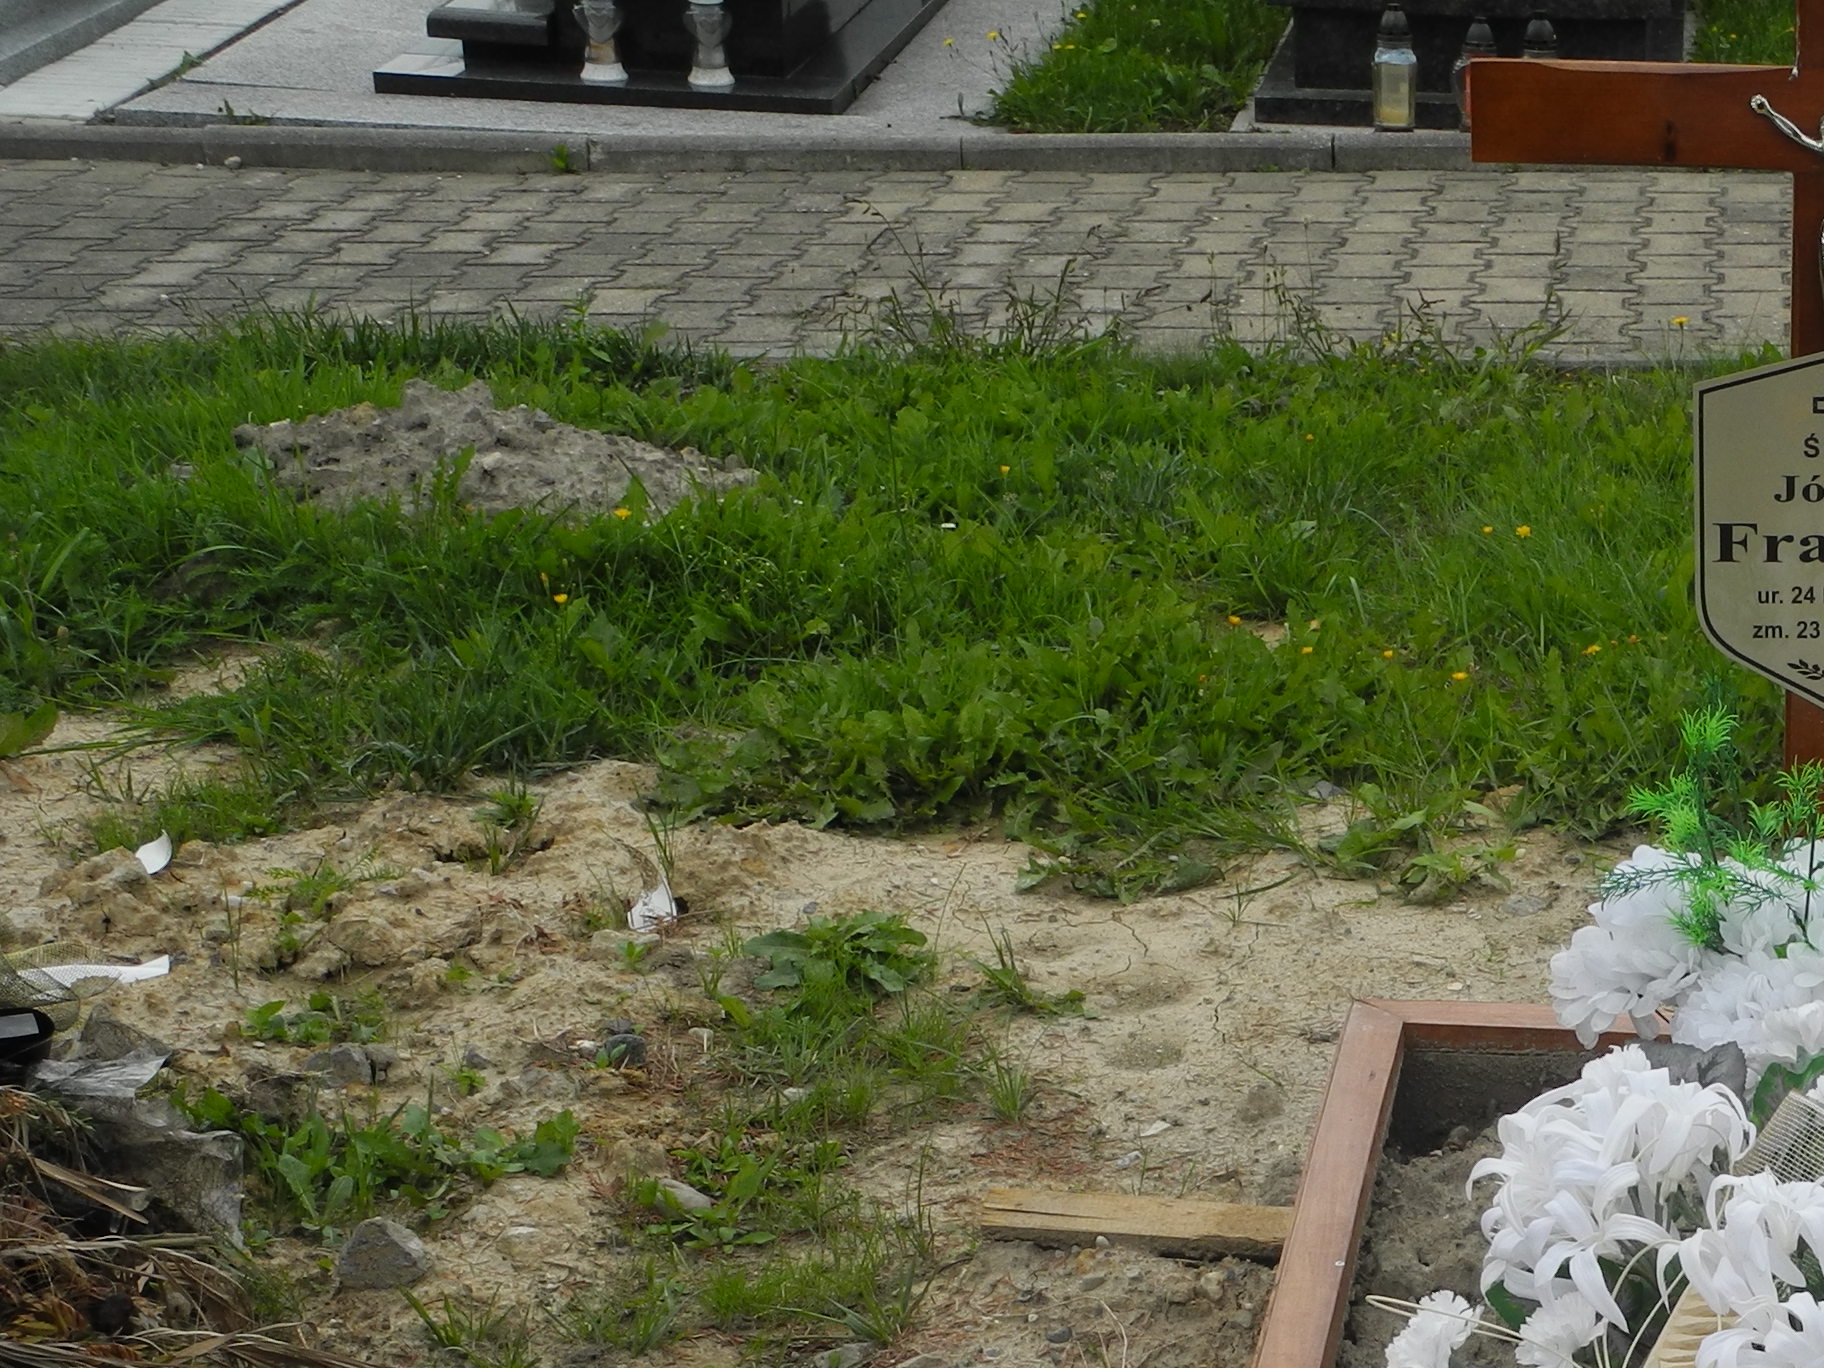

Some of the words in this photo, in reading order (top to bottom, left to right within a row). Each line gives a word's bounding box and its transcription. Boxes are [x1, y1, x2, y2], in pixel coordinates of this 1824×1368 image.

[1803, 432, 1820, 458] Ś
[1757, 590, 1784, 604] ur.
[1791, 586, 1816, 604] 24
[1752, 625, 1789, 639] zm.
[1796, 620, 1821, 639] 23
